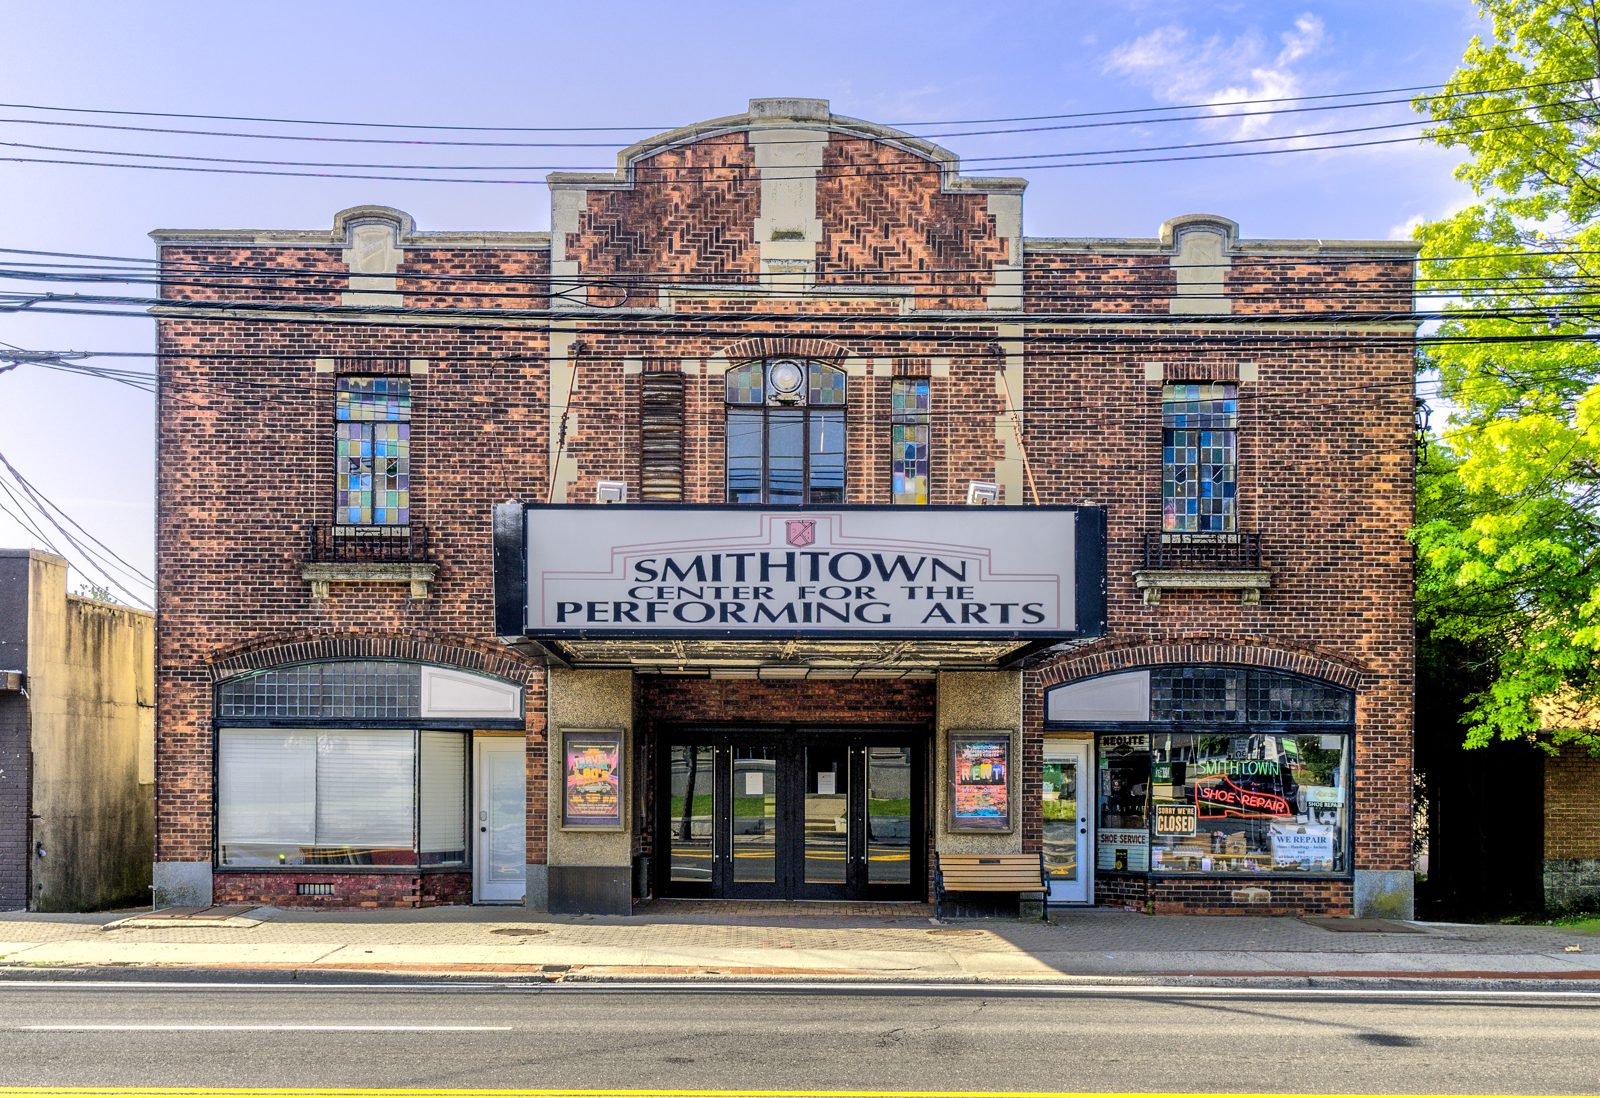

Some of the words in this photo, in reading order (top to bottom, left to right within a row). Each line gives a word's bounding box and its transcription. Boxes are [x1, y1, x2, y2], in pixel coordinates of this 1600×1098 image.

[634, 551, 967, 583] SMITHTOWN
[628, 586, 775, 600] CENTER
[798, 586, 877, 600] FOR
[900, 586, 974, 600] THE
[556, 601, 892, 624] PERFORMING
[920, 602, 1046, 624] ARTS
[1102, 735, 1145, 746] NEOLITE
[961, 766, 1002, 781] RENT
[1197, 760, 1279, 775] SMITHTOWN
[1202, 787, 1236, 803] SHOE
[1241, 794, 1285, 813] REPAIR
[1158, 807, 1176, 815] SORRY
[1177, 807, 1195, 815] WE'RE
[1157, 815, 1195, 832] CLOSED
[1101, 833, 1118, 844] SHOE
[1119, 834, 1146, 845] SERVICE
[1277, 835, 1291, 844] WE
[1293, 835, 1327, 844] REPAIR
